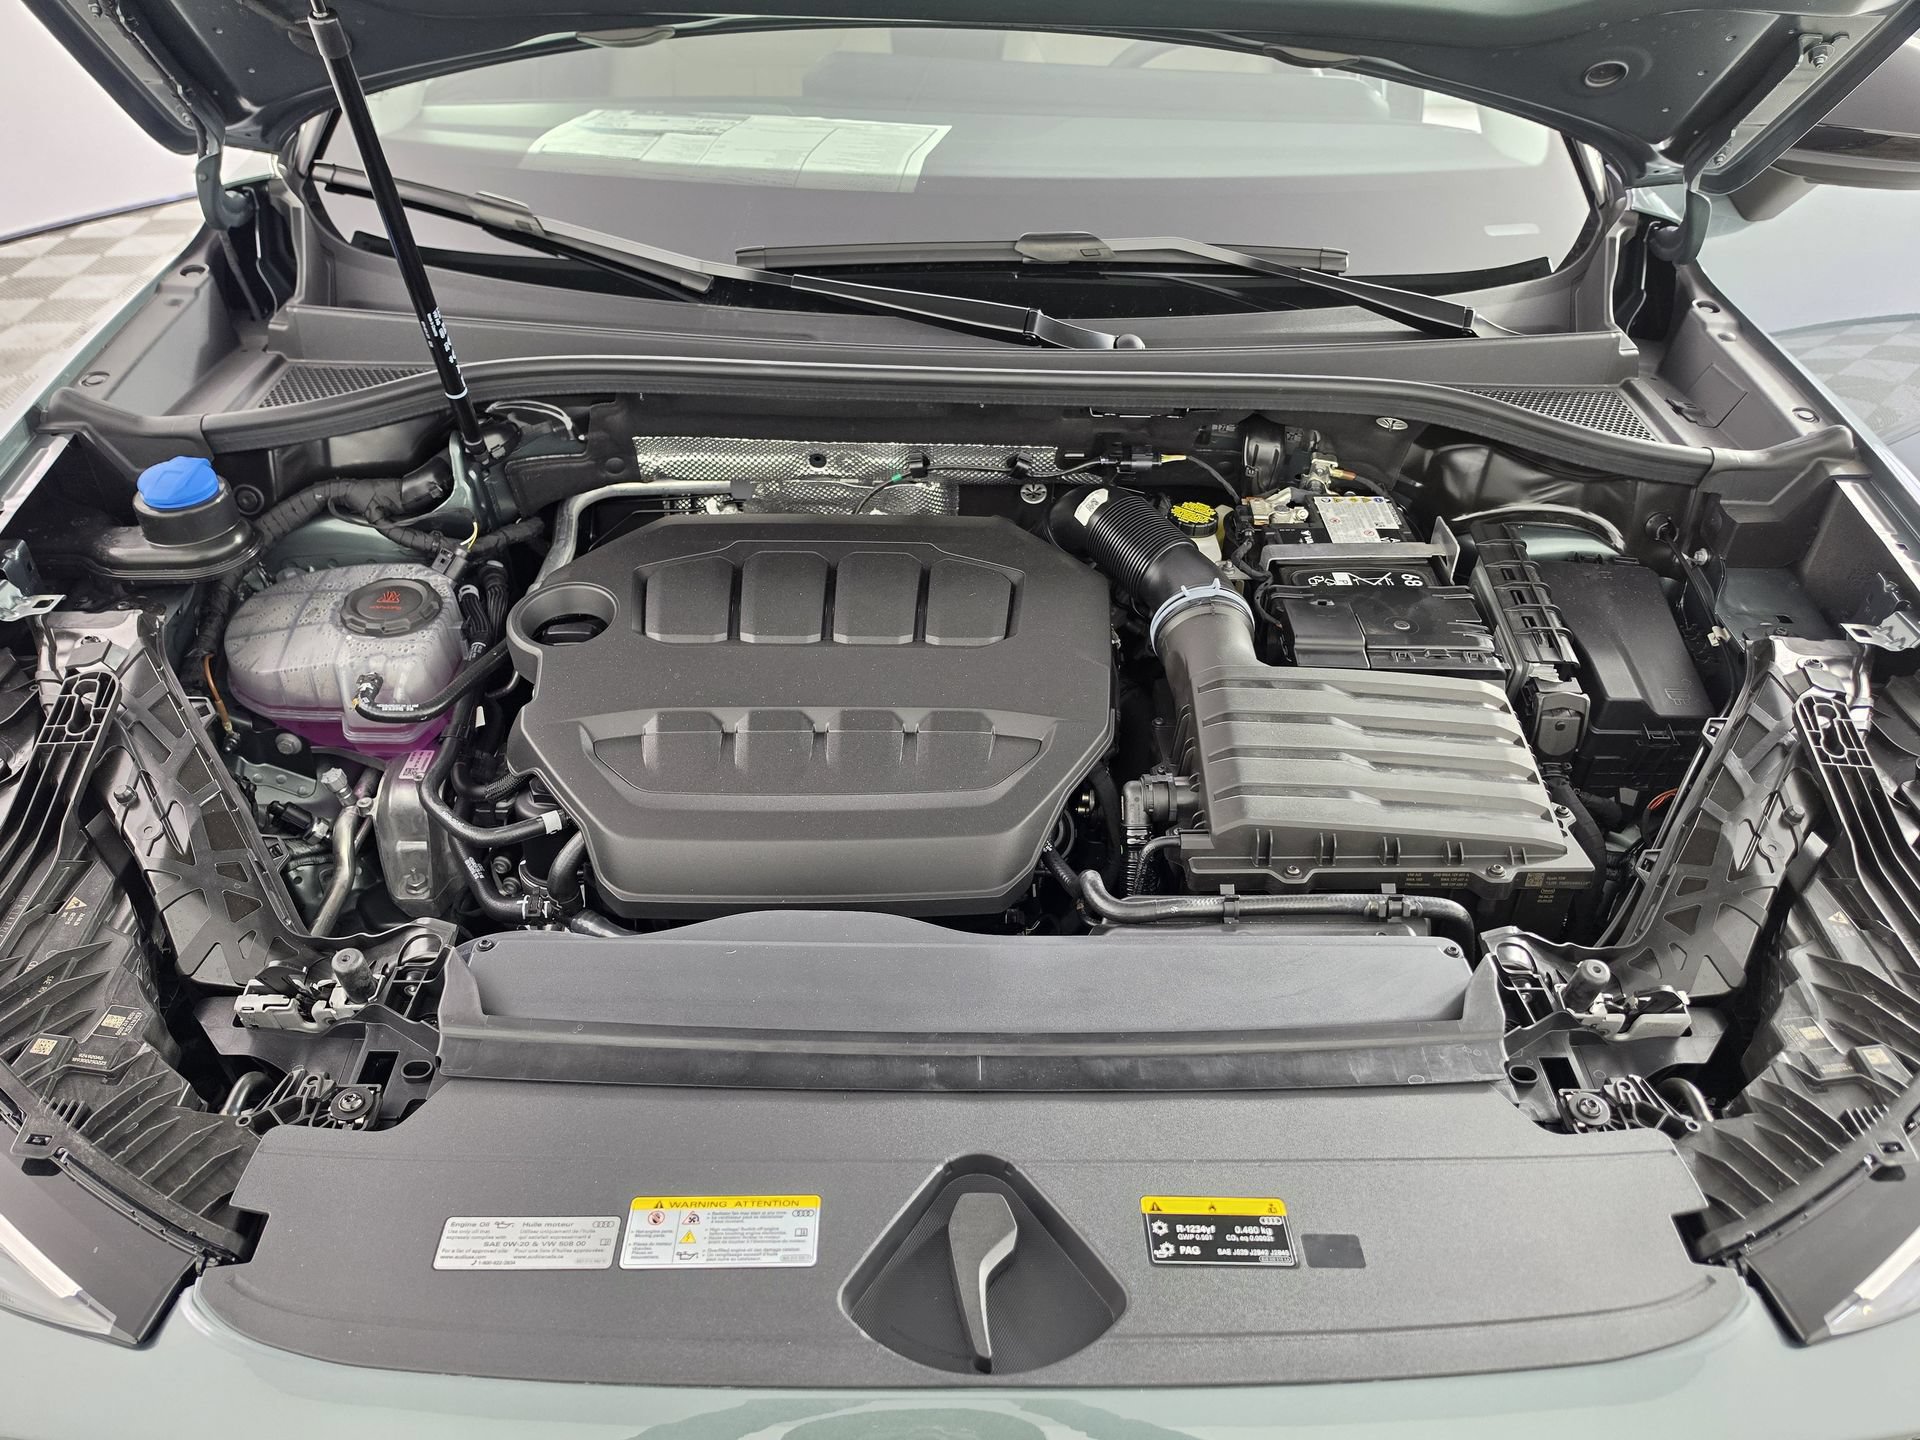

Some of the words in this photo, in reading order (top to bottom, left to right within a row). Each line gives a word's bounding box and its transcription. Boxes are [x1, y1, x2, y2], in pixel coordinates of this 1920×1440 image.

[1401, 574, 1423, 586] 68
[669, 1200, 727, 1208] WARNING
[734, 1200, 800, 1208] ATTENTION
[1176, 1225, 1216, 1235] R-1234yf
[1260, 1226, 1273, 1236] kg
[1179, 1246, 1202, 1255] PAG
